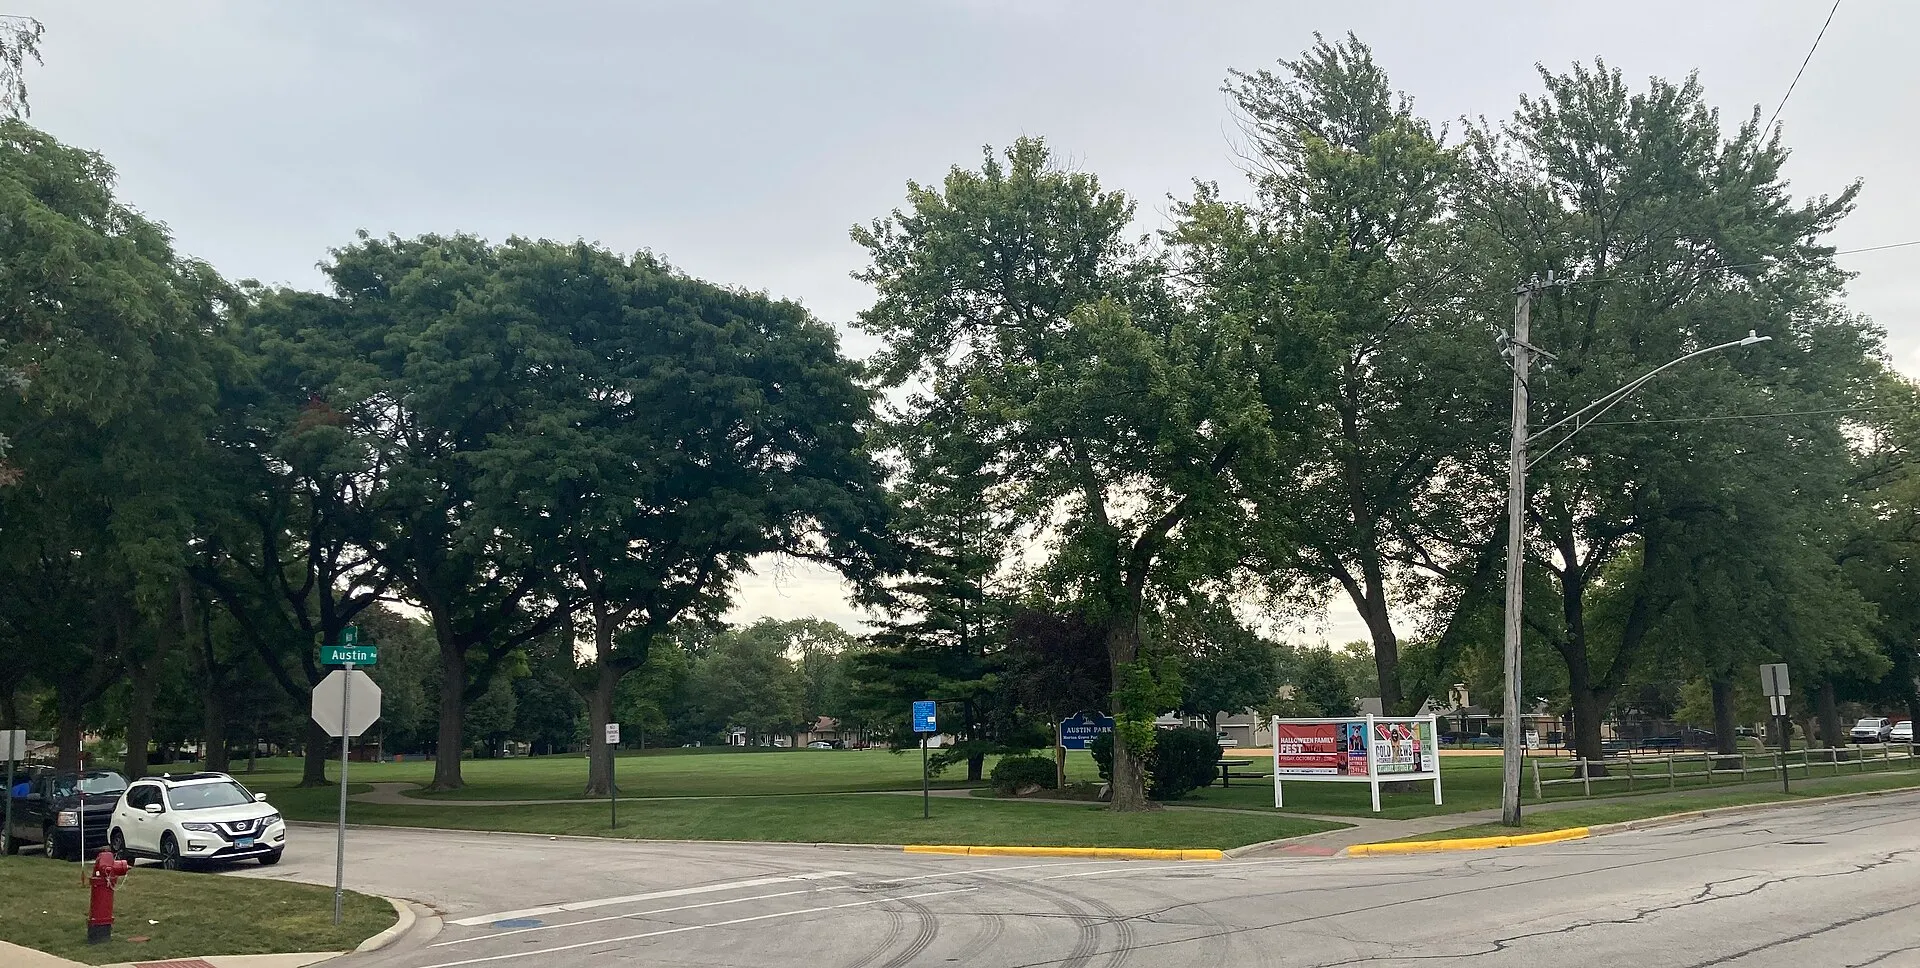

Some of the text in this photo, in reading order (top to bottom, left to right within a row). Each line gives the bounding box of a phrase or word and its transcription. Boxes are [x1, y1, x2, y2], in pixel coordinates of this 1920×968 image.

[332, 650, 367, 660] Austin
[1280, 744, 1303, 753] FEST
[1375, 745, 1391, 757] COLD
